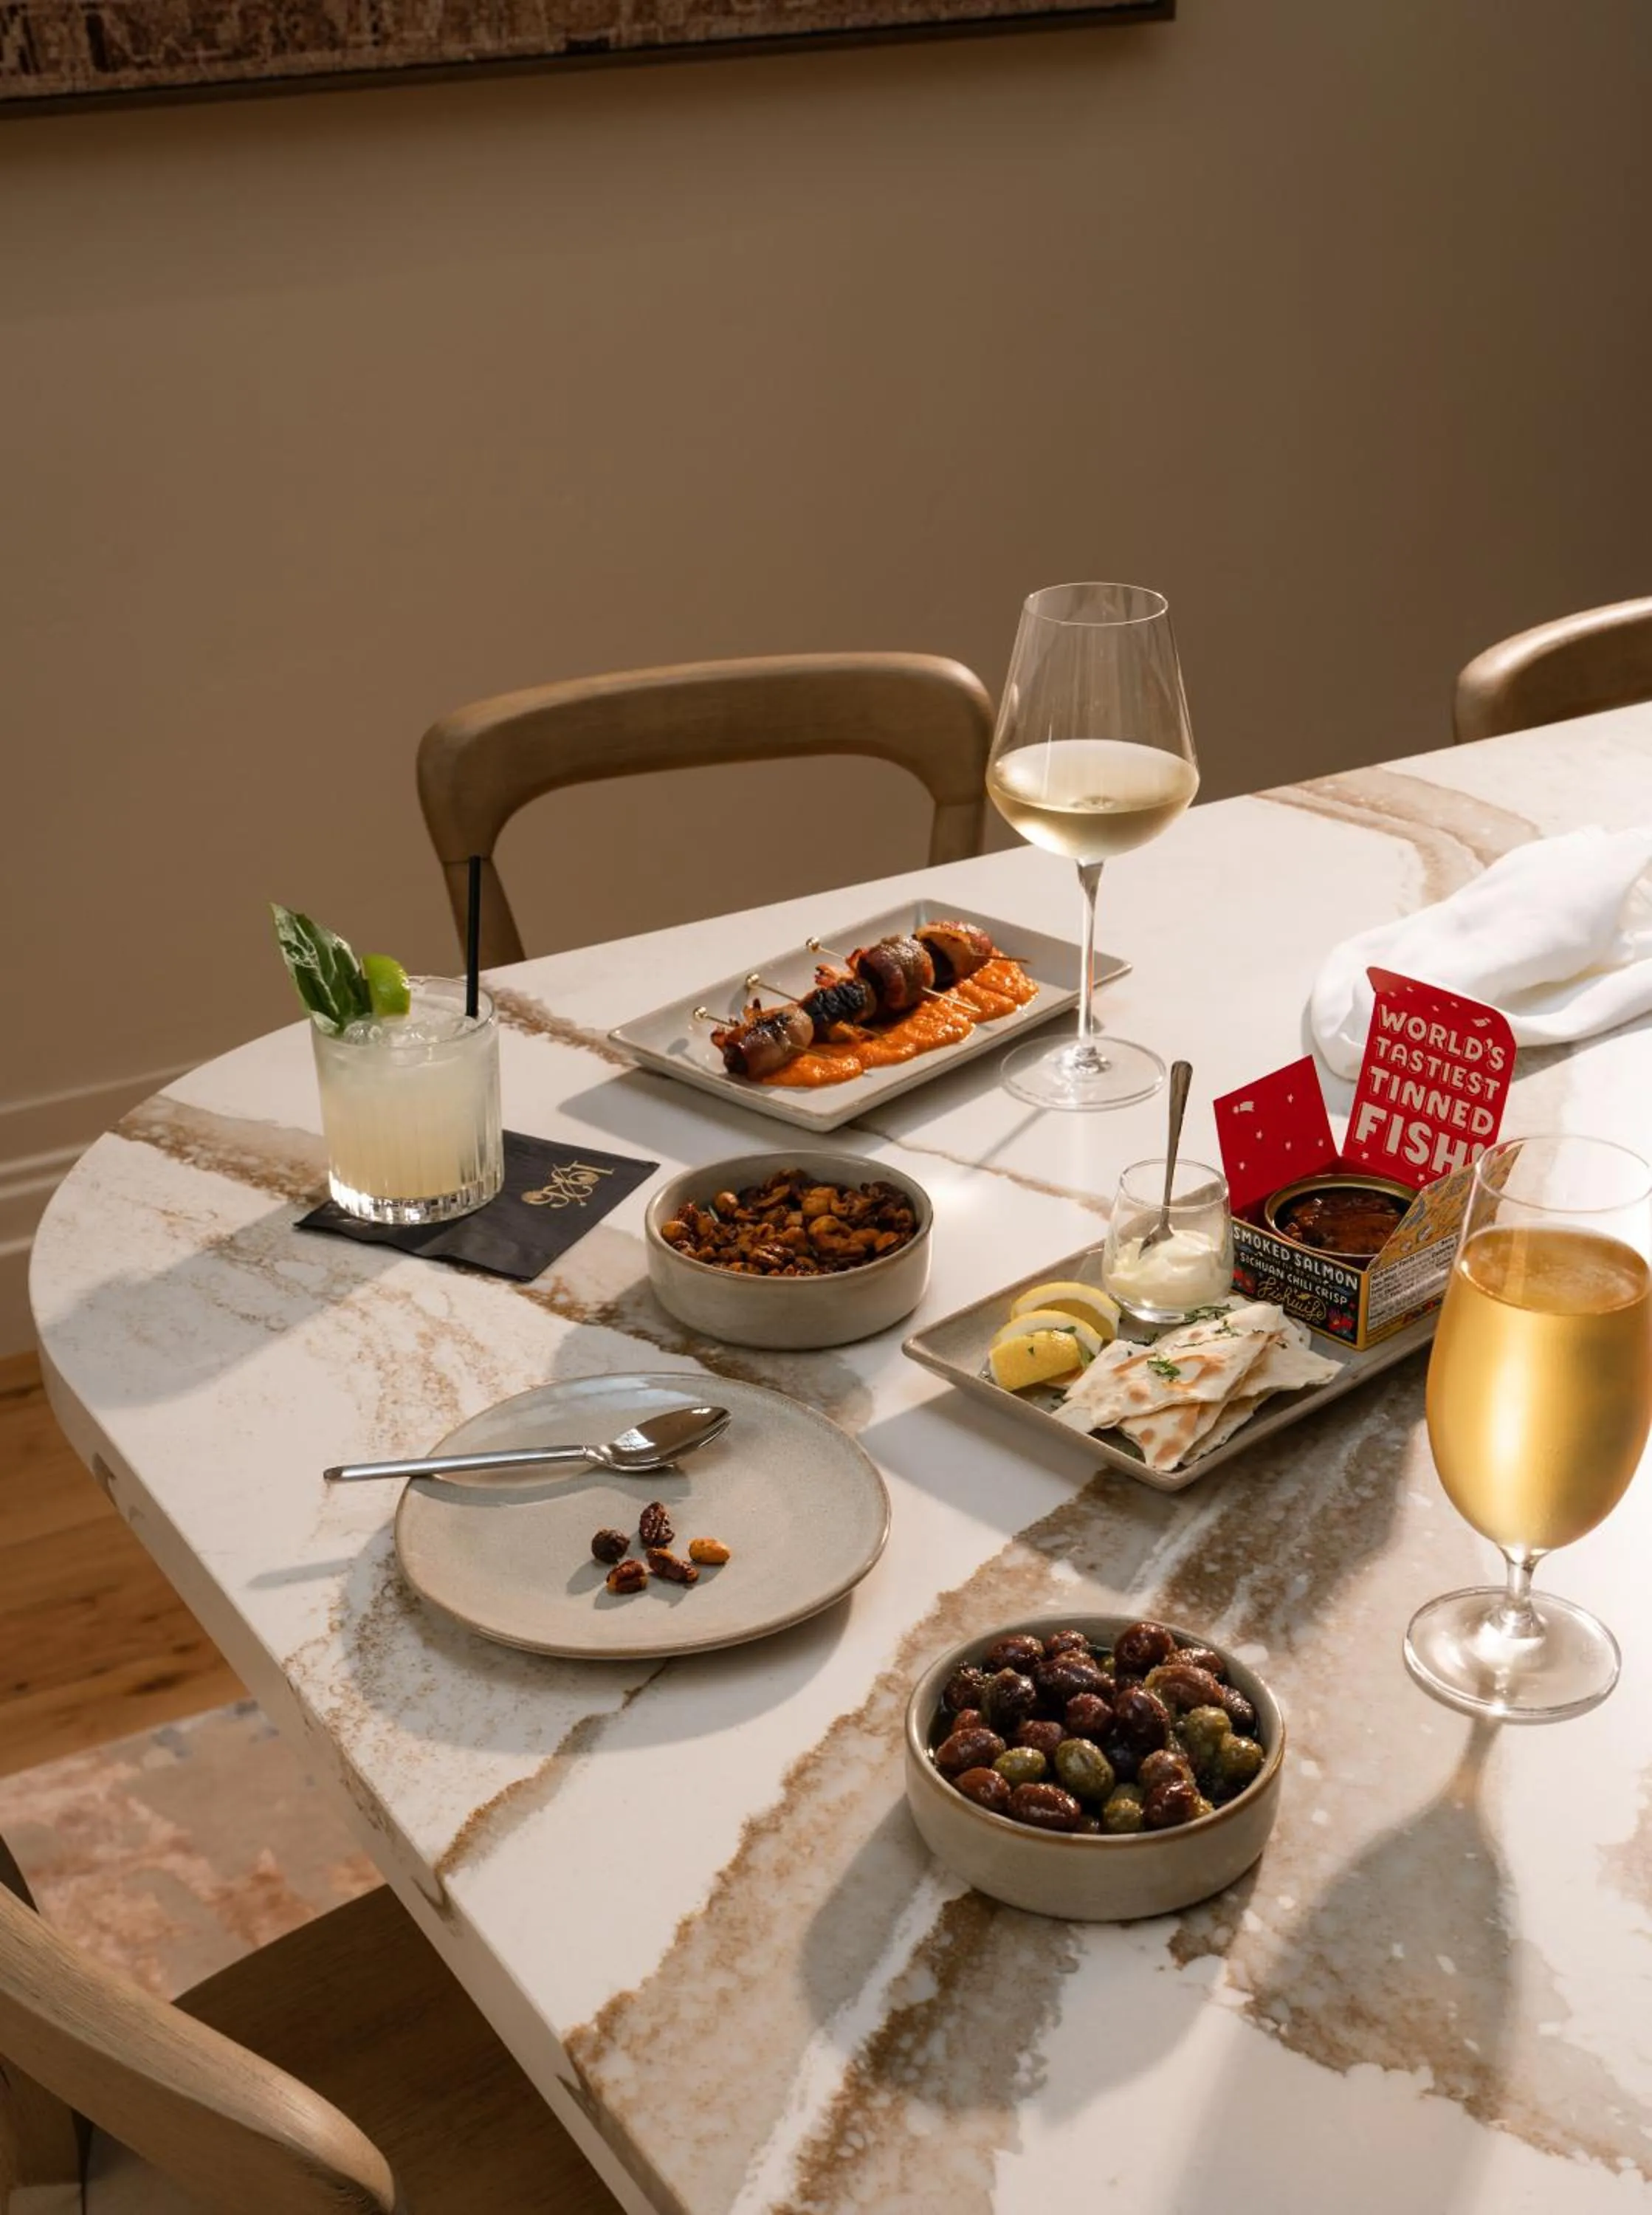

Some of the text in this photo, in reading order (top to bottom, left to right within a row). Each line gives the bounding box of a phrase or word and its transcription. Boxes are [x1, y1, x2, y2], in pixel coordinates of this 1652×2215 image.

[1375, 1036, 1501, 1101] TASTIEST
[1379, 1003, 1505, 1071] WORLD'S
[1369, 1065, 1495, 1136] TINNED
[1233, 1226, 1290, 1261] SMOKED
[1294, 1253, 1357, 1291] SALMON
[1239, 1251, 1284, 1280] SICHUAN
[1287, 1273, 1312, 1291] CHILI
[1315, 1285, 1348, 1305] CRISP
